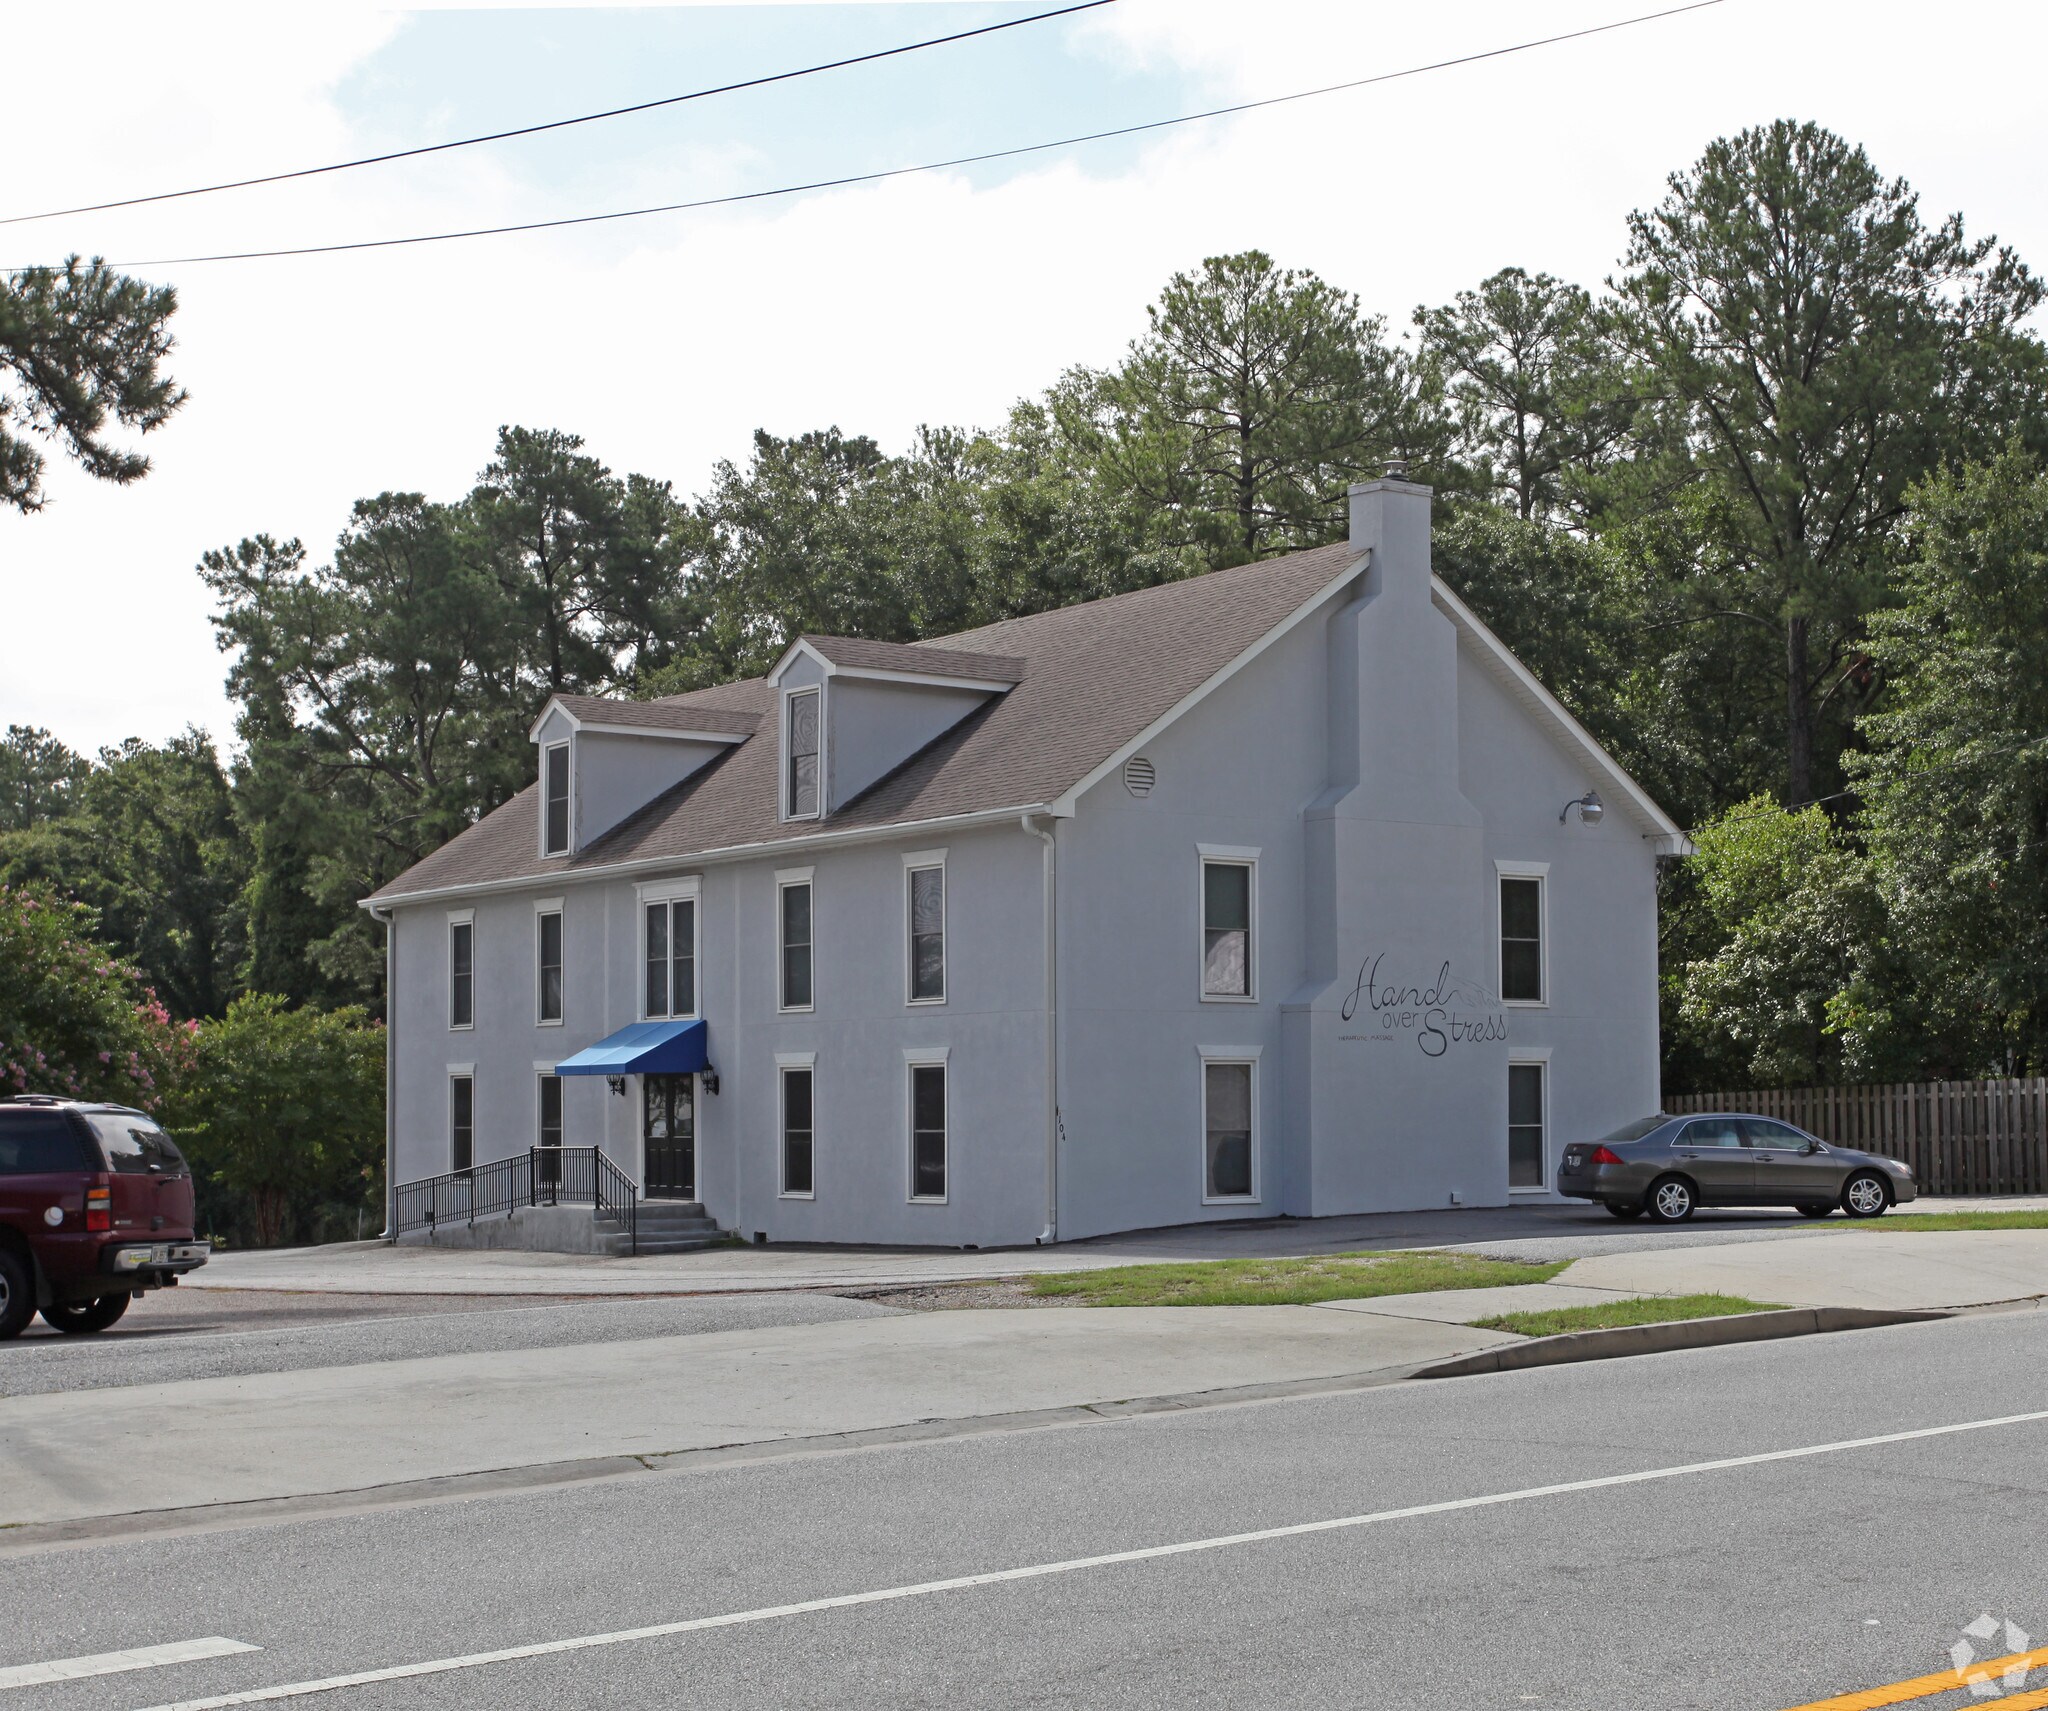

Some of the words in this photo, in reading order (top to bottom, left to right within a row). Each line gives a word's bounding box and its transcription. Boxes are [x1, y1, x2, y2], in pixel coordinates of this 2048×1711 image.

[1341, 953, 1458, 1021] Hand
[1383, 1013, 1418, 1029] over
[1418, 1009, 1509, 1058] Stress
